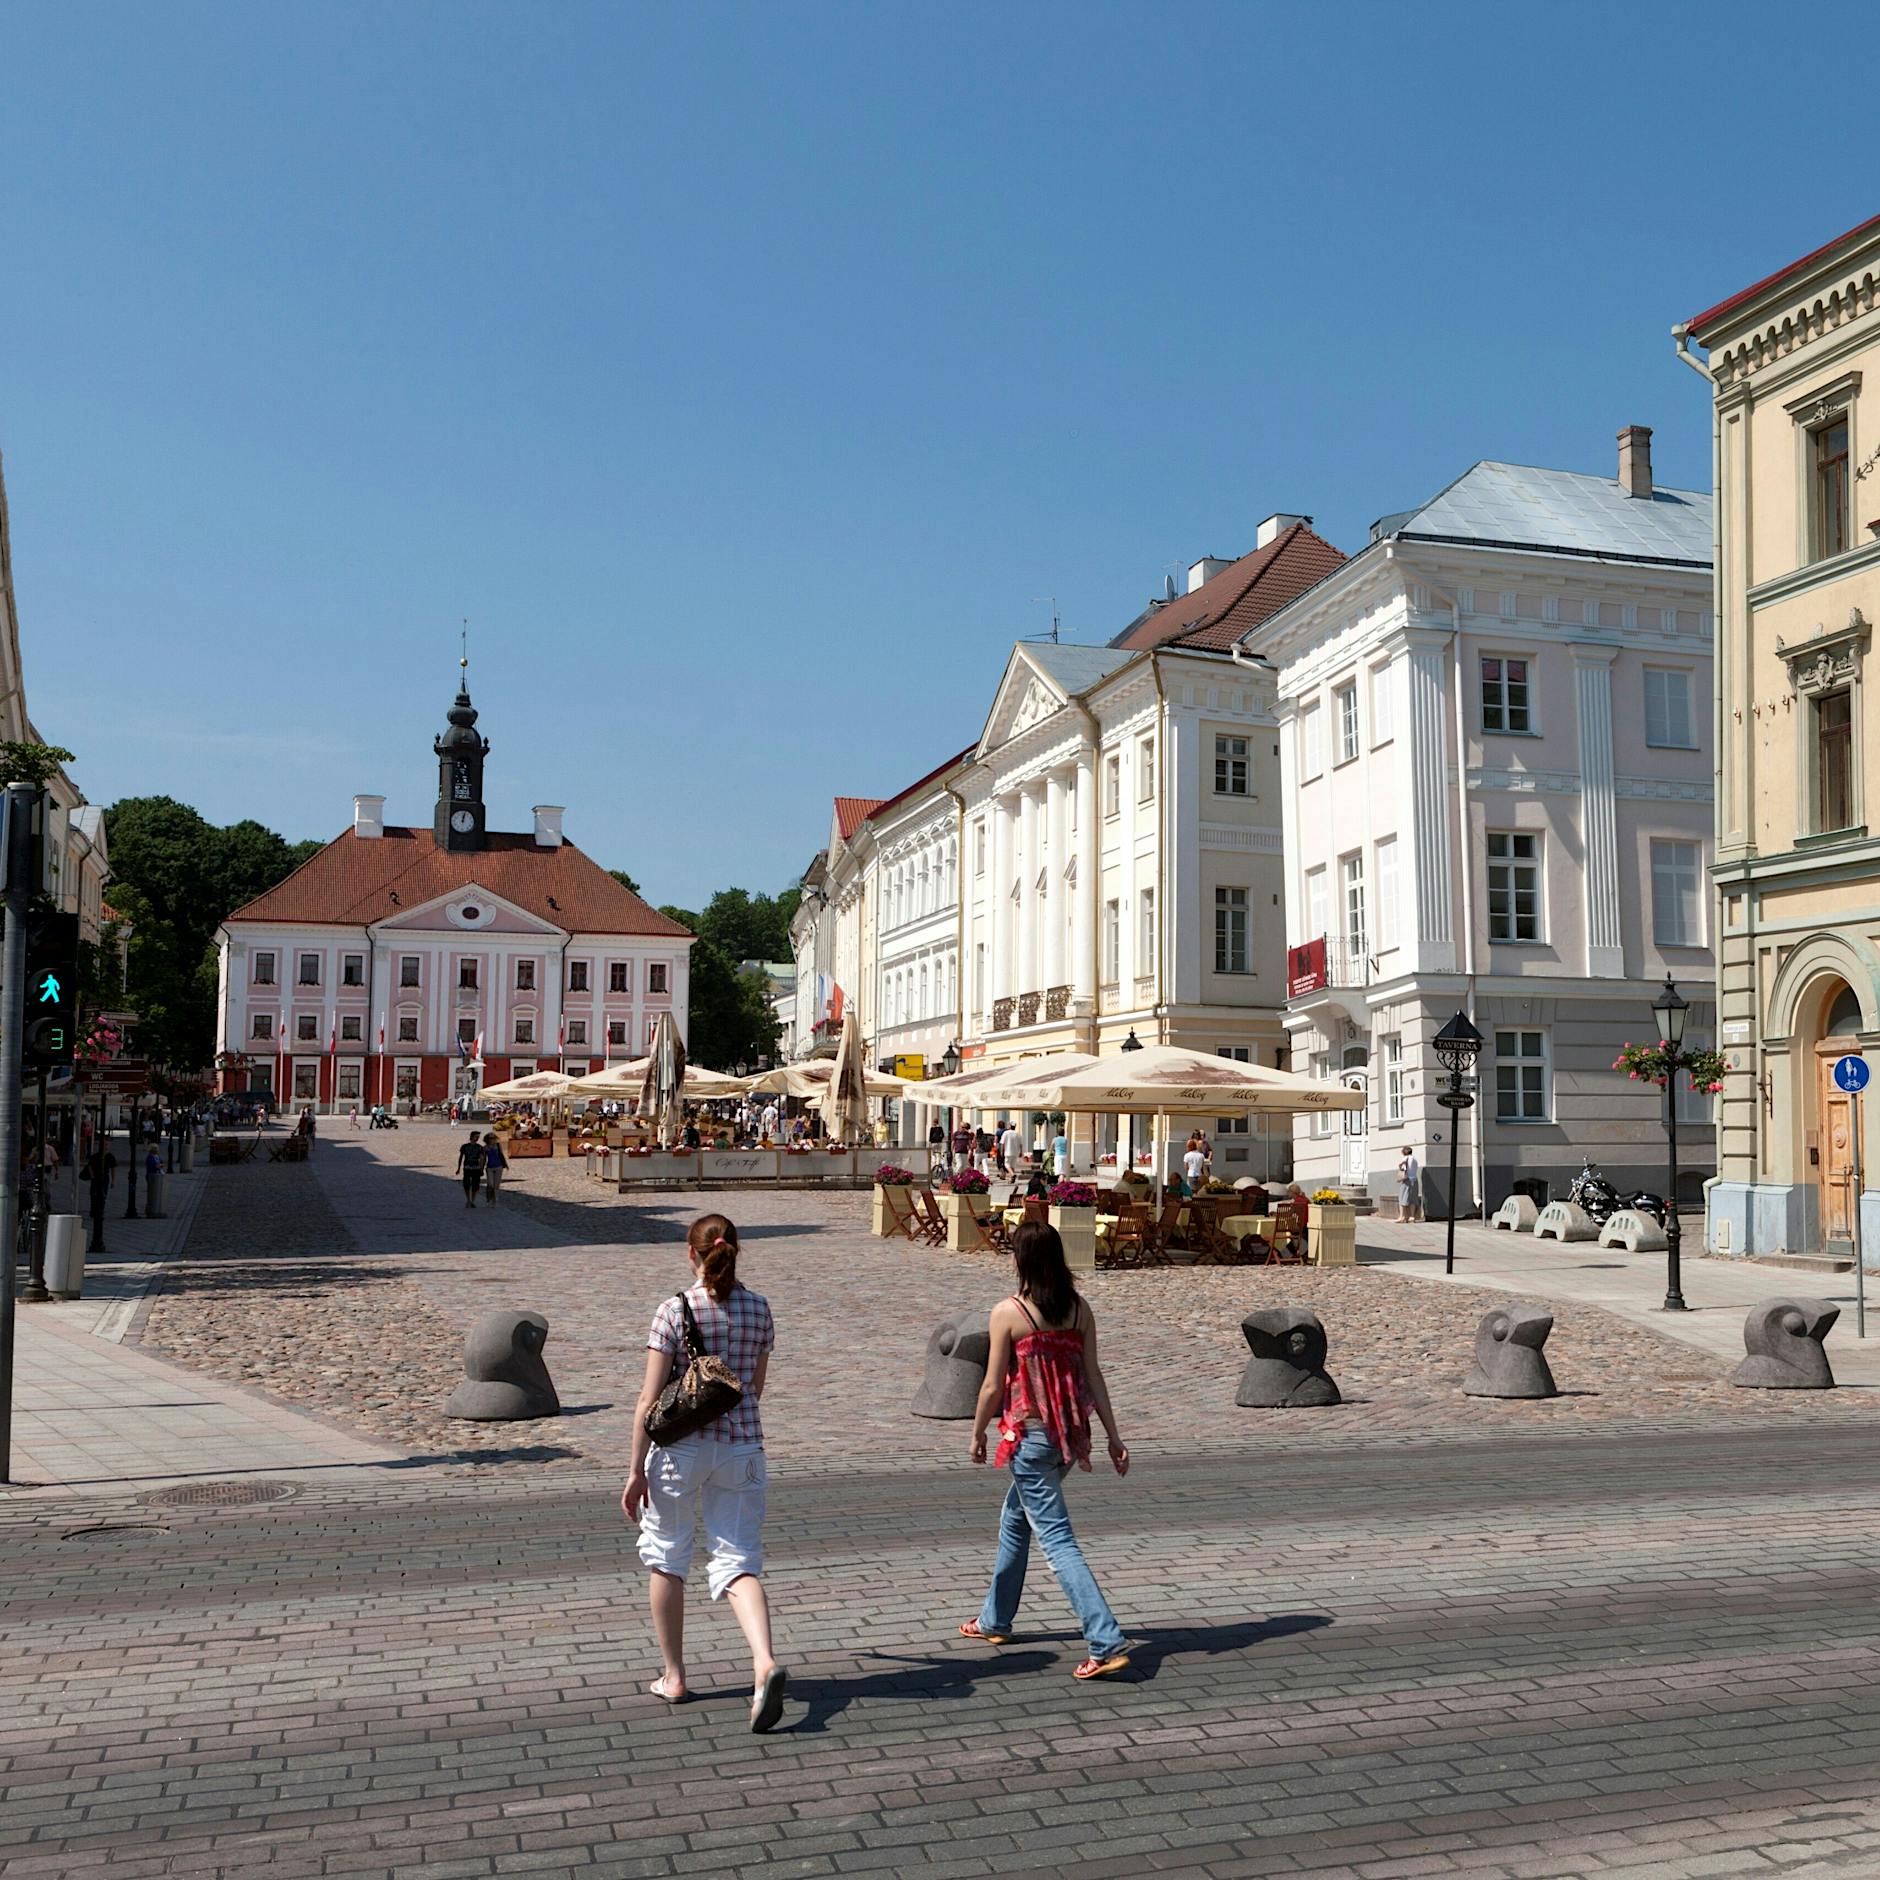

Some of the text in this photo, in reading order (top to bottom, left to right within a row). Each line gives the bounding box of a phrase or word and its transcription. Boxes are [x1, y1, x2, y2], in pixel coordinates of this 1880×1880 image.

[51, 1028, 63, 1050] 3
[1437, 1041, 1478, 1050] TAVERNA
[91, 1072, 104, 1081] WC
